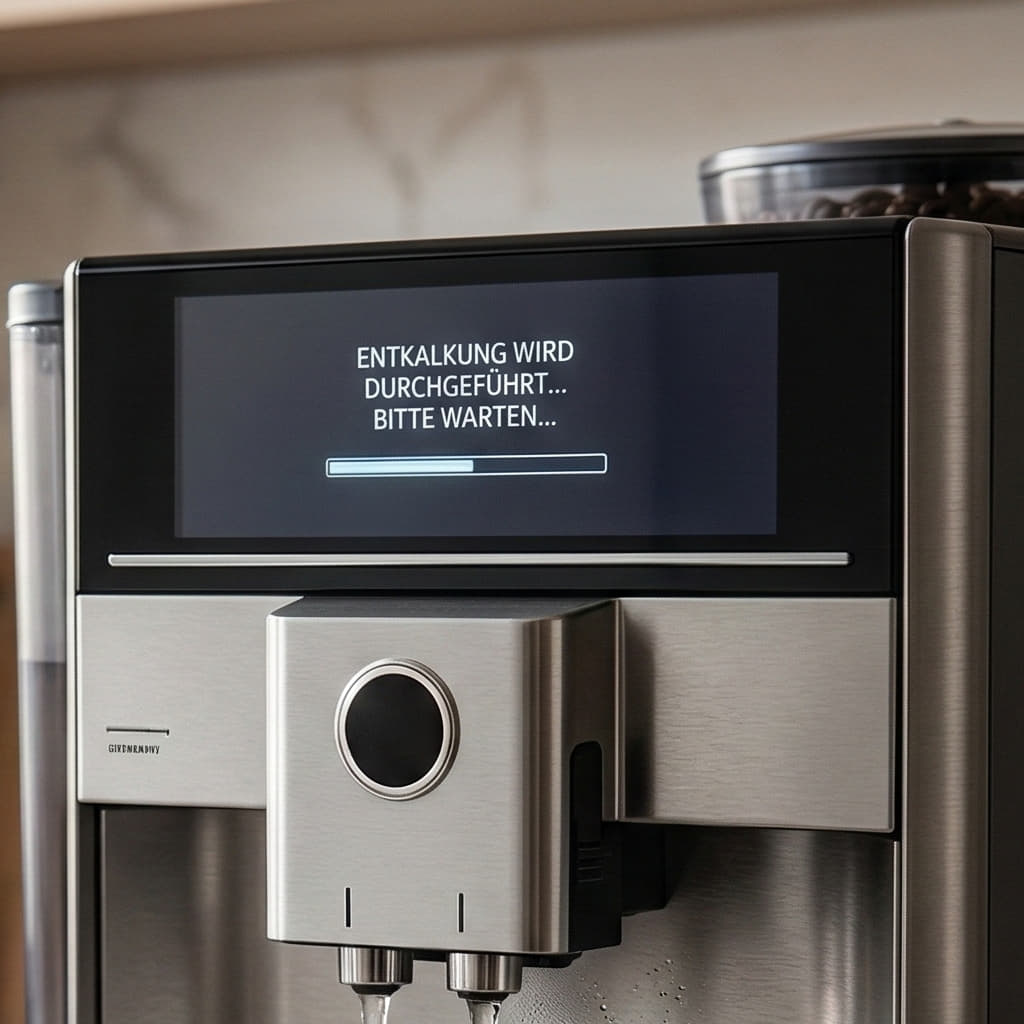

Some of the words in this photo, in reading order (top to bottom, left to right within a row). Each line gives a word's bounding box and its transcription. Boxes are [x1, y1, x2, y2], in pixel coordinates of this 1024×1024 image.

[357, 344, 507, 369] ENTKALKUNG
[513, 340, 574, 363] WIRD
[365, 368, 566, 399] DURCHGEFÜHRT...
[374, 407, 435, 430] BITTE
[441, 405, 556, 428] WARTEN...
